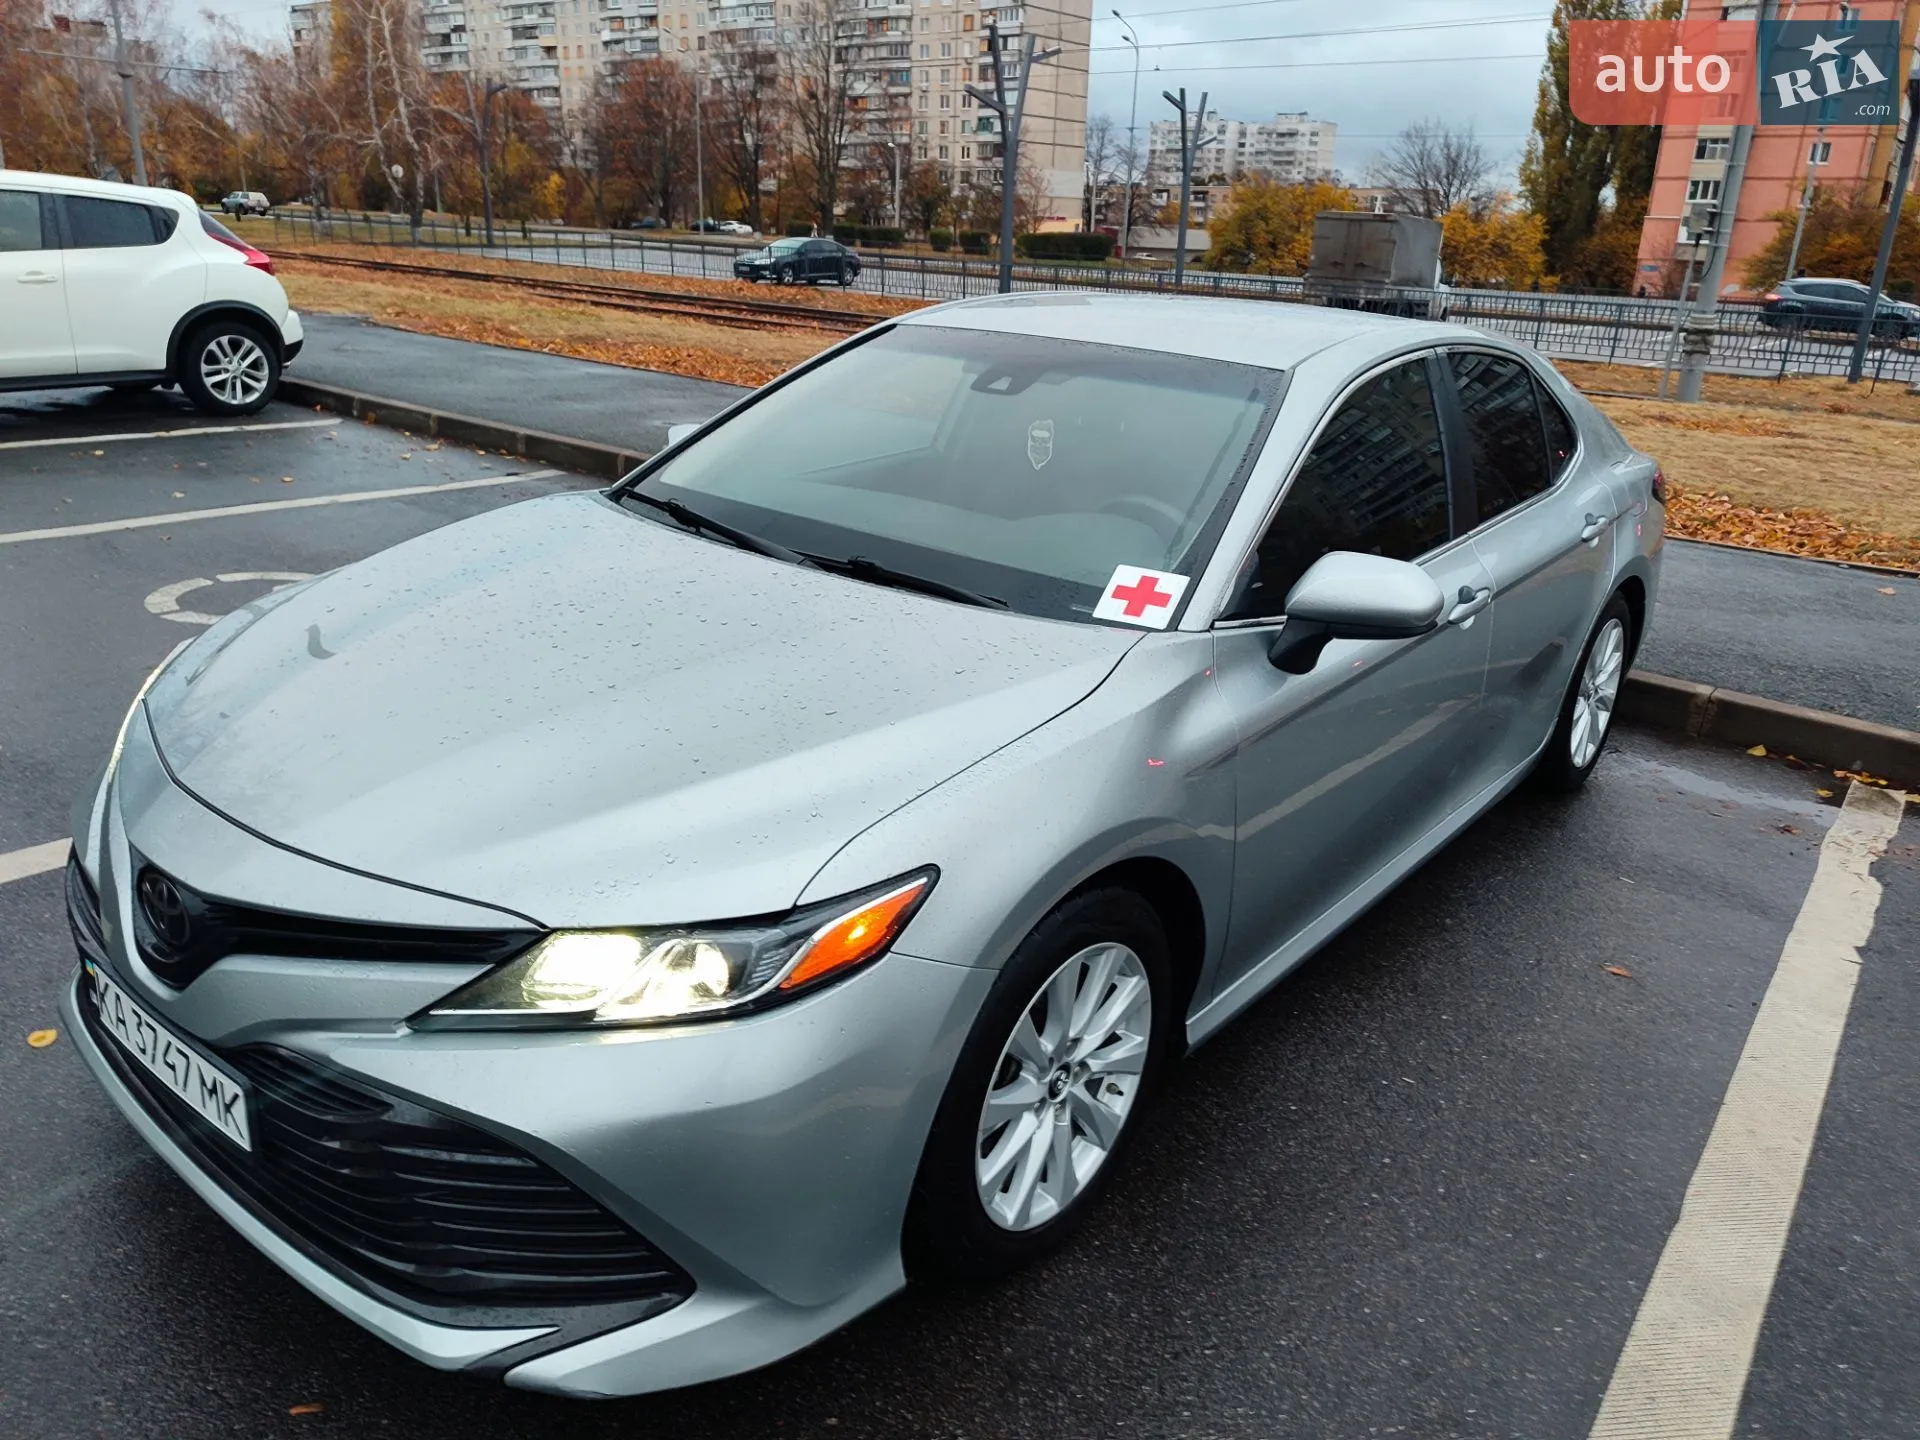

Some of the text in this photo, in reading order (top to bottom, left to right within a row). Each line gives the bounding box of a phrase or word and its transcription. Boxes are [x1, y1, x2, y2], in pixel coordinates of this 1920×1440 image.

[96, 971, 245, 1141] KA 3747 MK
